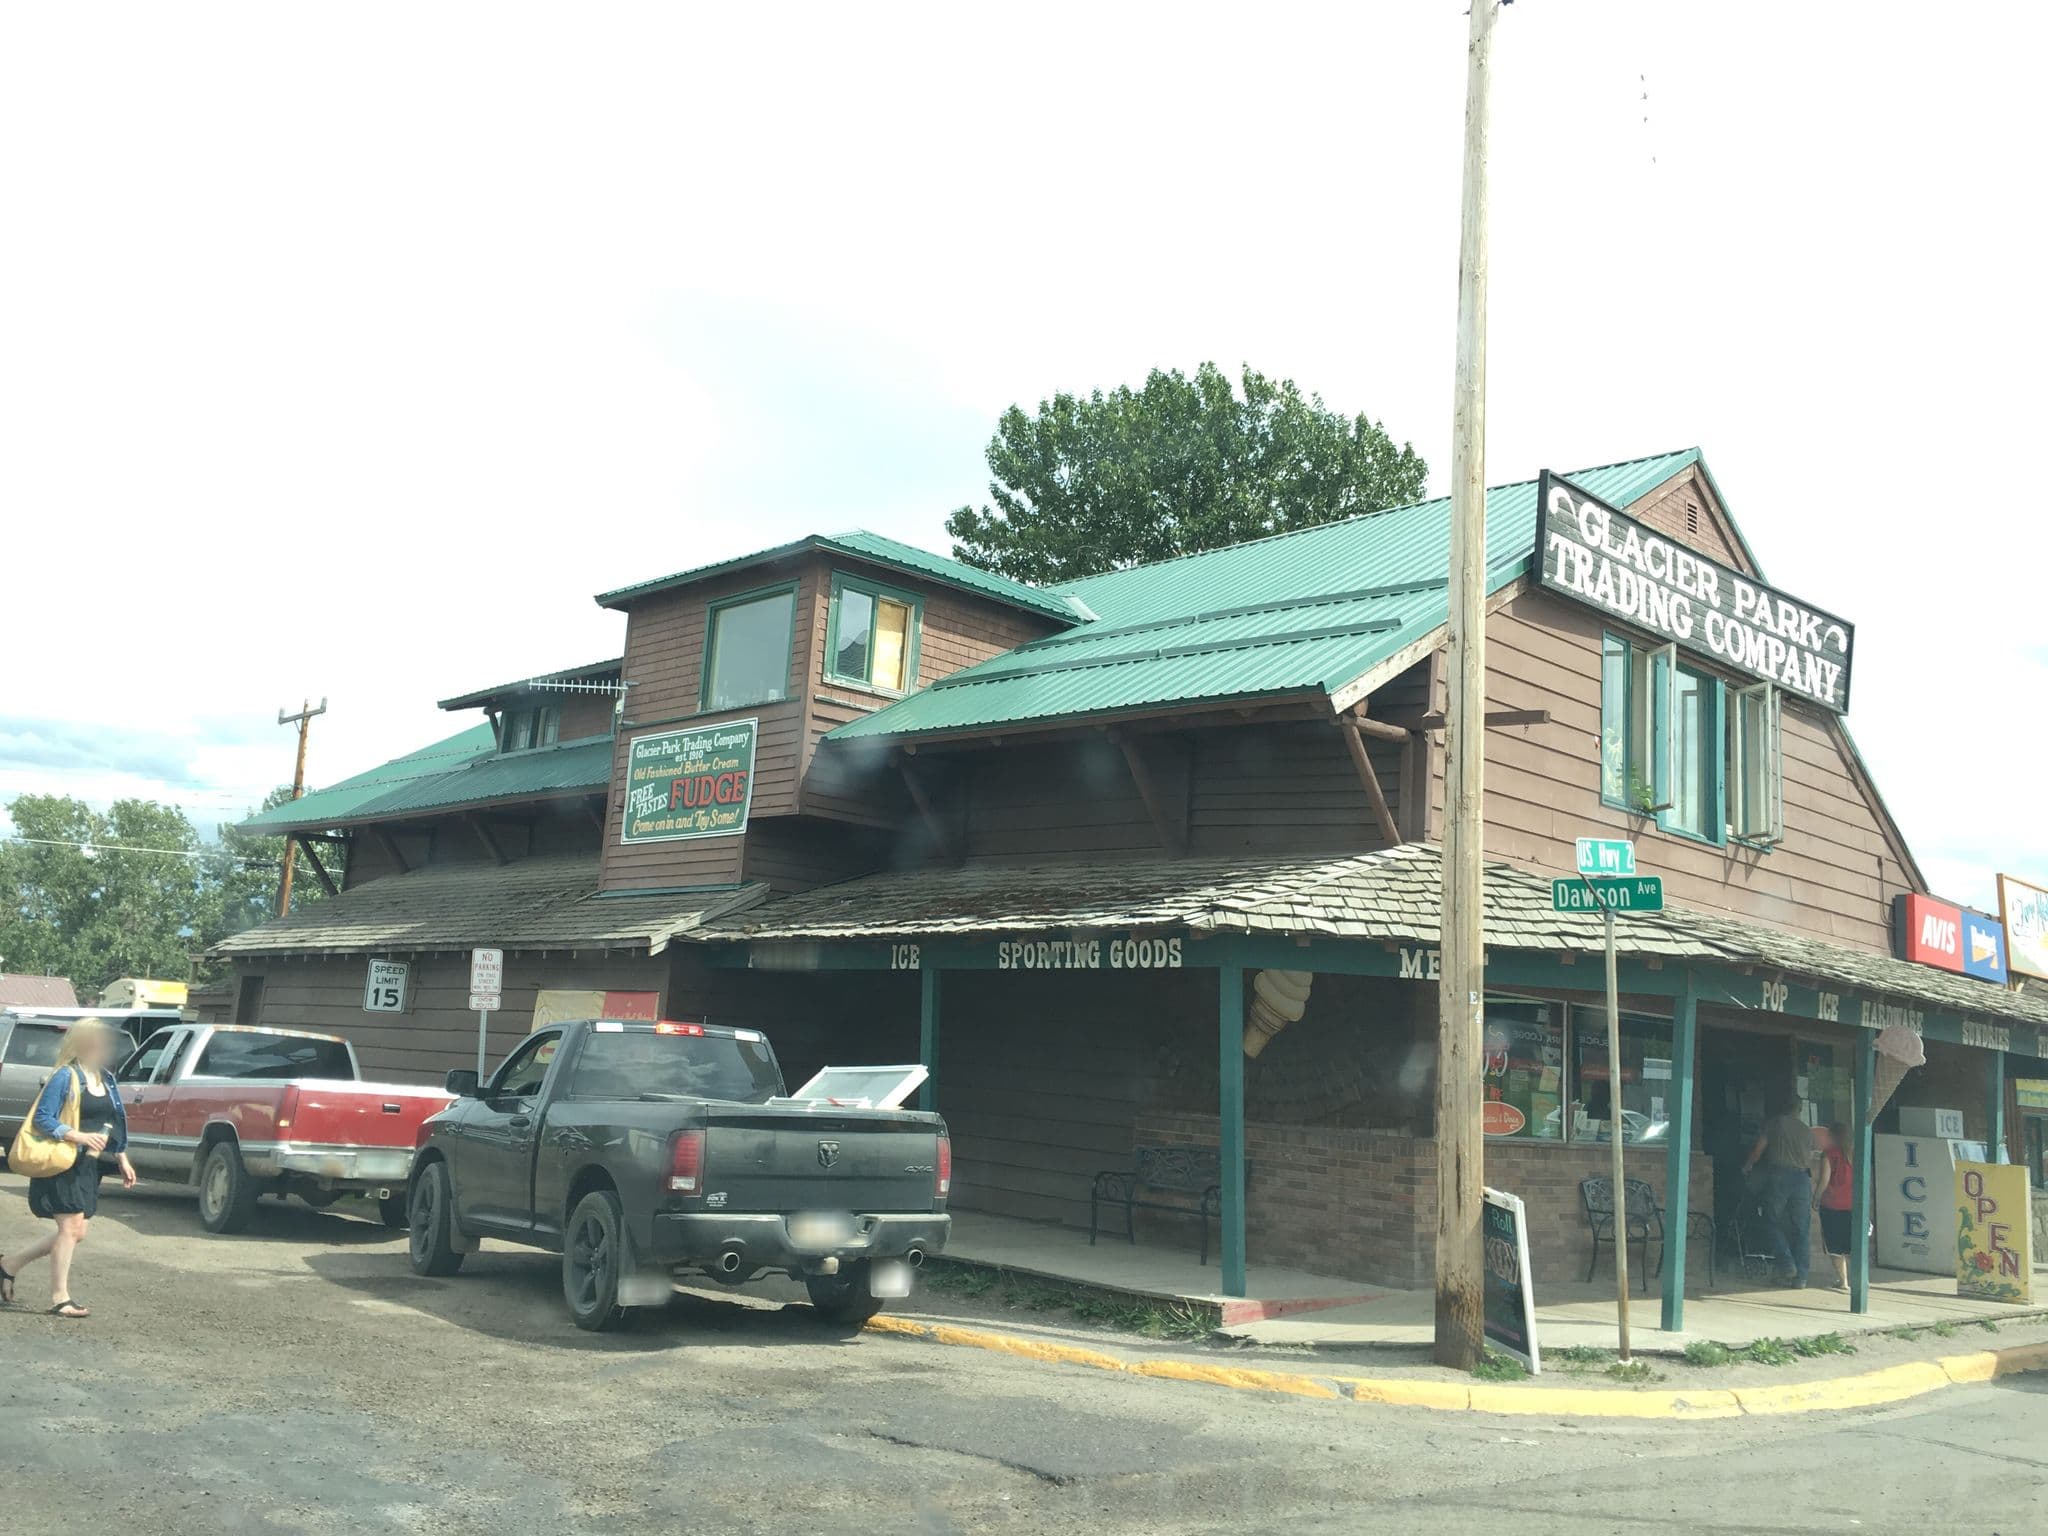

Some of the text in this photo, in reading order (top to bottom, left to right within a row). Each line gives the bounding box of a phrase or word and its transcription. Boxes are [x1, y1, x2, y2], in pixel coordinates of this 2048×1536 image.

[1578, 501, 1823, 653] GLACIER PARK
[1550, 532, 1841, 704] TRADING COMPANY
[636, 732, 750, 758] Glacier Park Trading Company
[634, 757, 739, 780] Old Fashioned Butter Cream
[628, 783, 655, 813] FREE
[670, 770, 747, 809] FUDGE
[636, 792, 669, 819] TASTES
[632, 819, 655, 836] Come
[675, 813, 694, 829] and
[695, 810, 710, 831] Try
[710, 808, 740, 828] Some!
[1579, 841, 1633, 873] US Hwy 2
[1557, 881, 1657, 908] Dawson Ave
[1921, 914, 1956, 956] AVIS
[474, 963, 500, 971] PARKING
[481, 952, 494, 961] NO
[891, 944, 920, 970] ICE
[999, 938, 1182, 970] SPORTING GOODS
[374, 965, 405, 975] SPEED
[375, 976, 400, 985] LIMIT
[373, 987, 399, 1007] 15
[1761, 981, 1789, 1013] POP
[1818, 991, 1839, 1022] ICE
[1940, 1115, 1960, 1133] ICE
[1902, 1141, 1929, 1239] ICE
[1963, 1170, 2020, 1279] OPEN
